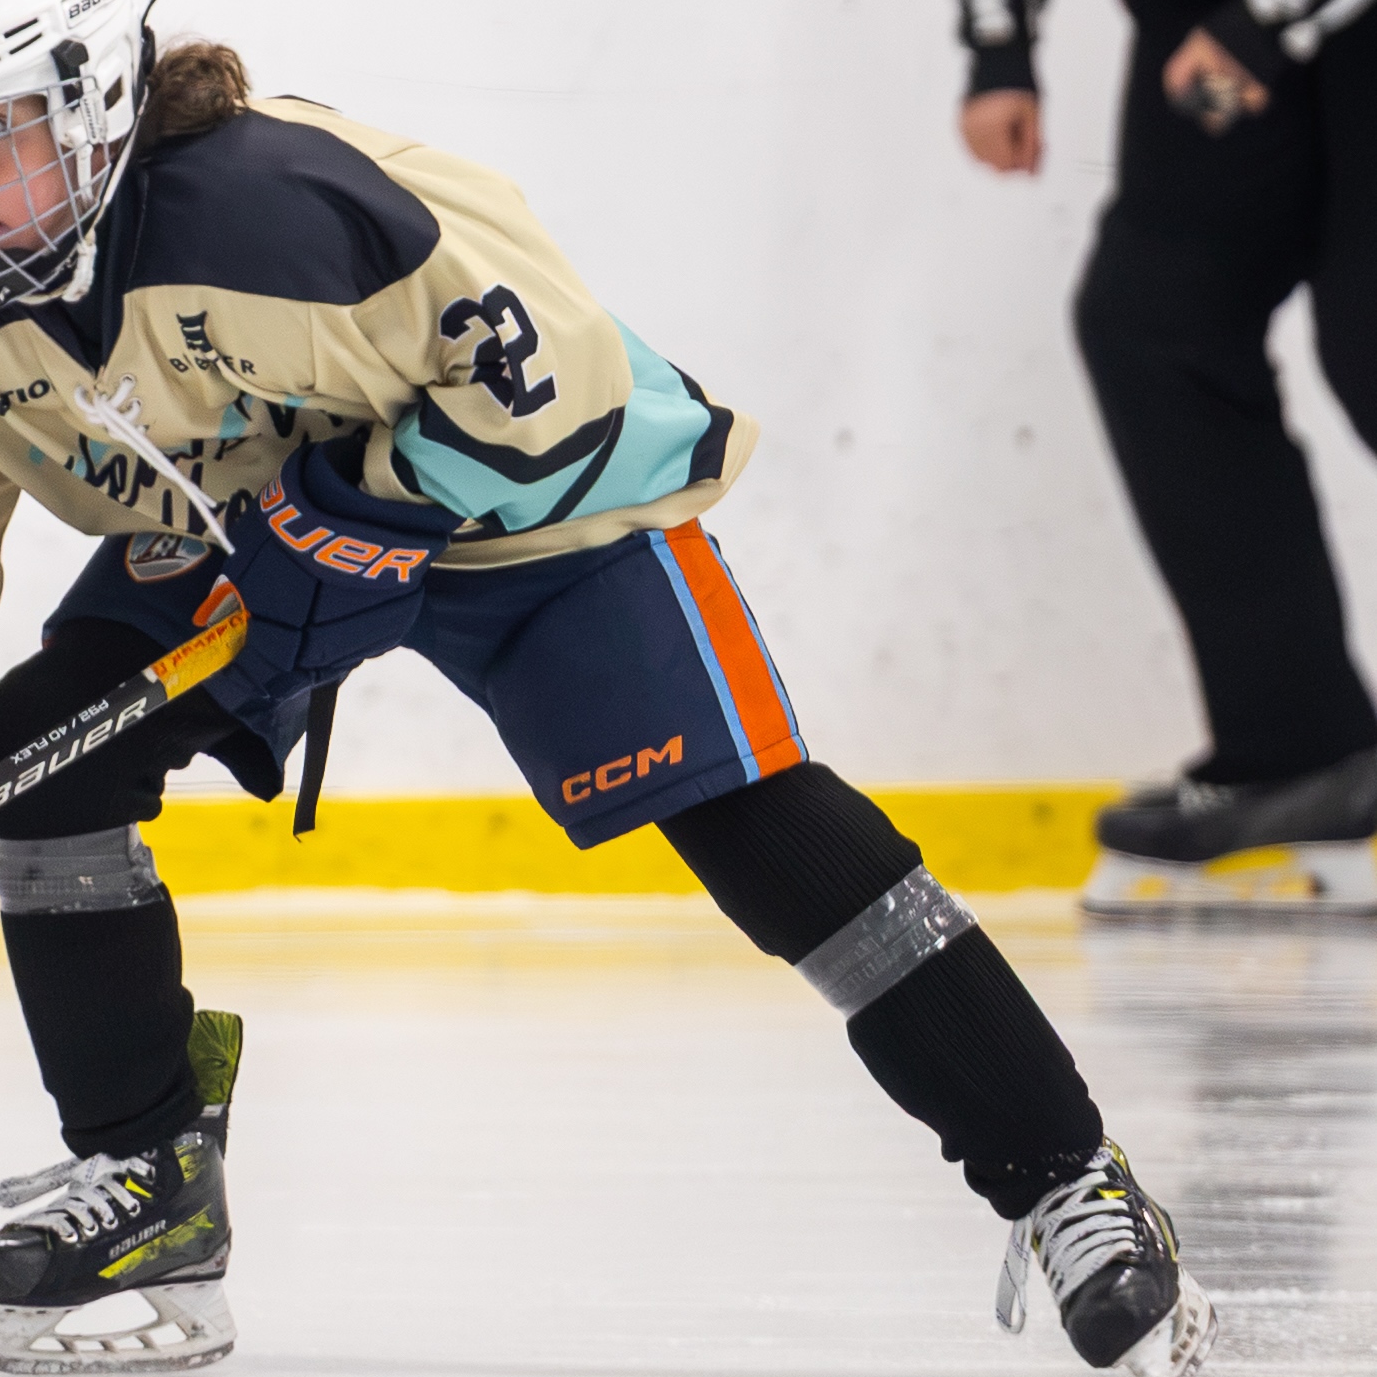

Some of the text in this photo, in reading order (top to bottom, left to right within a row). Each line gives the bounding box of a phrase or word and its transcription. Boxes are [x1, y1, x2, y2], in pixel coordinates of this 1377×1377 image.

[259, 478, 430, 583] AUER
[78, 698, 110, 723] P92
[9, 737, 50, 765] FLEX
[561, 734, 683, 805] CCM
